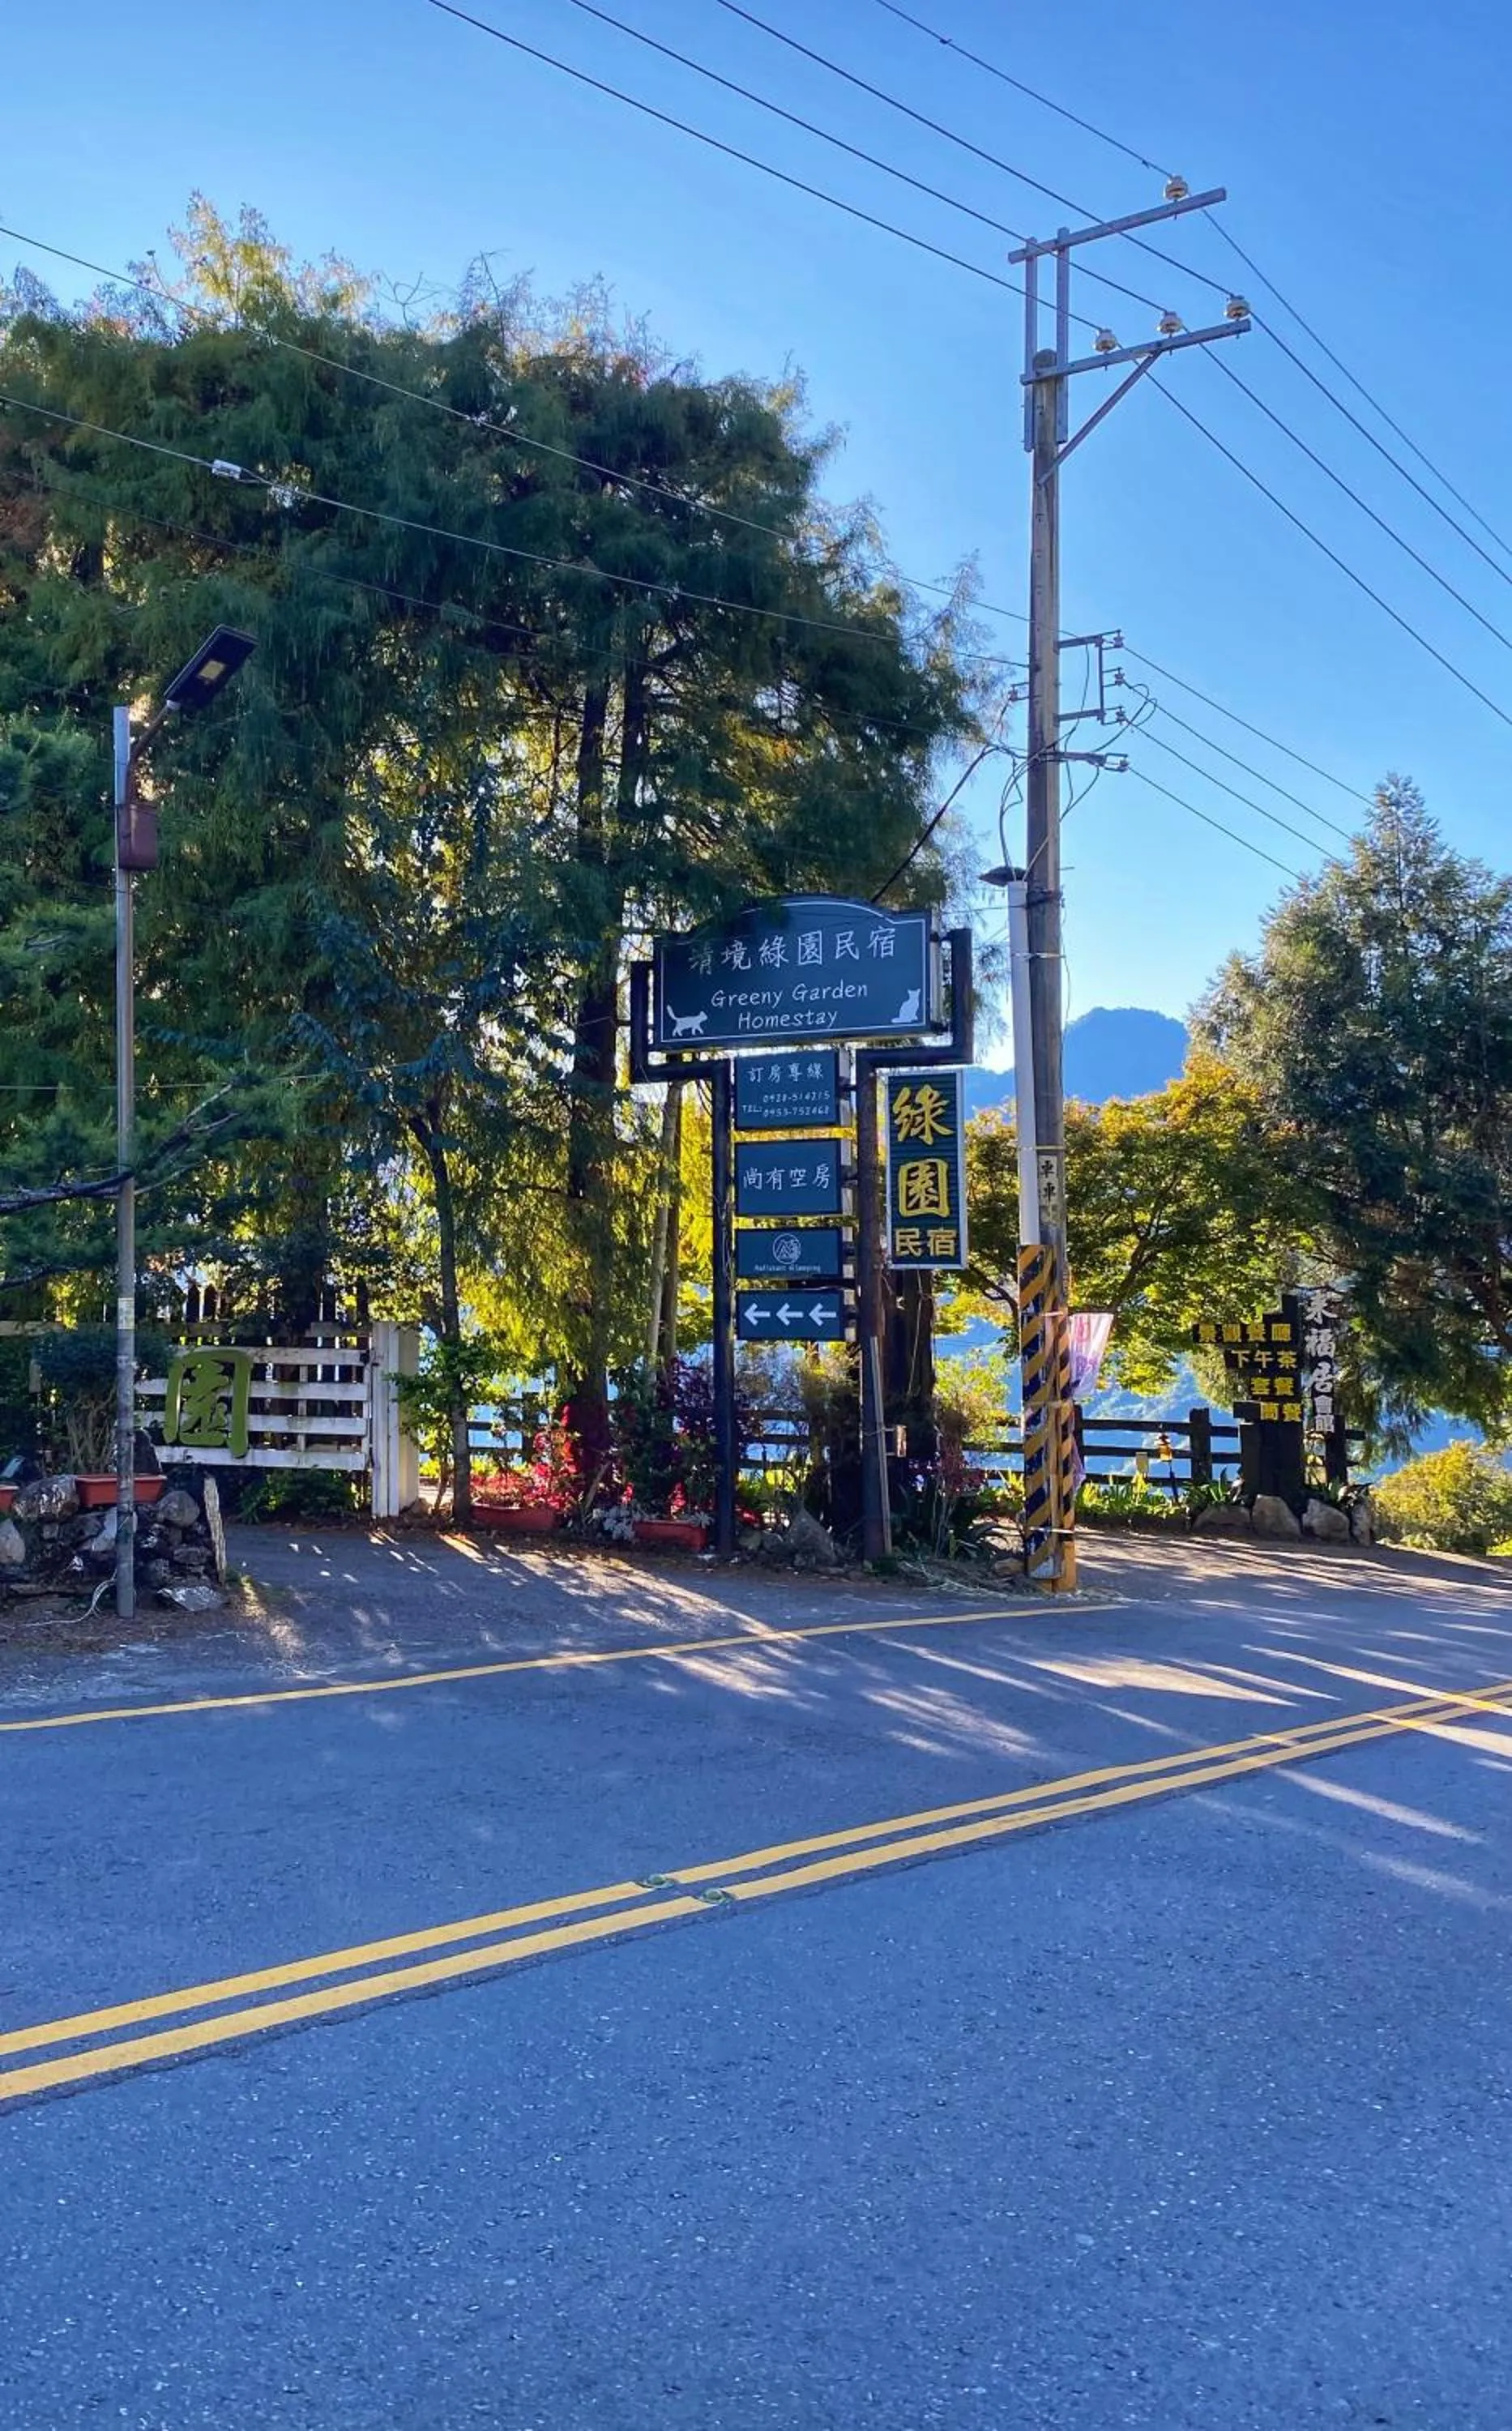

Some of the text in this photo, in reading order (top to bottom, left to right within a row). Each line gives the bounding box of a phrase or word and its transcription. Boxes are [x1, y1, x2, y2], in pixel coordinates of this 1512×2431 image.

[711, 980, 869, 1008] Greeny Garden
[738, 1010, 839, 1031] Homestay
[745, 1062, 824, 1083] 訂房專線
[742, 1164, 831, 1191] 尚有空房
[895, 1228, 958, 1257] 民宿
[1231, 1349, 1297, 1369] 下午茶
